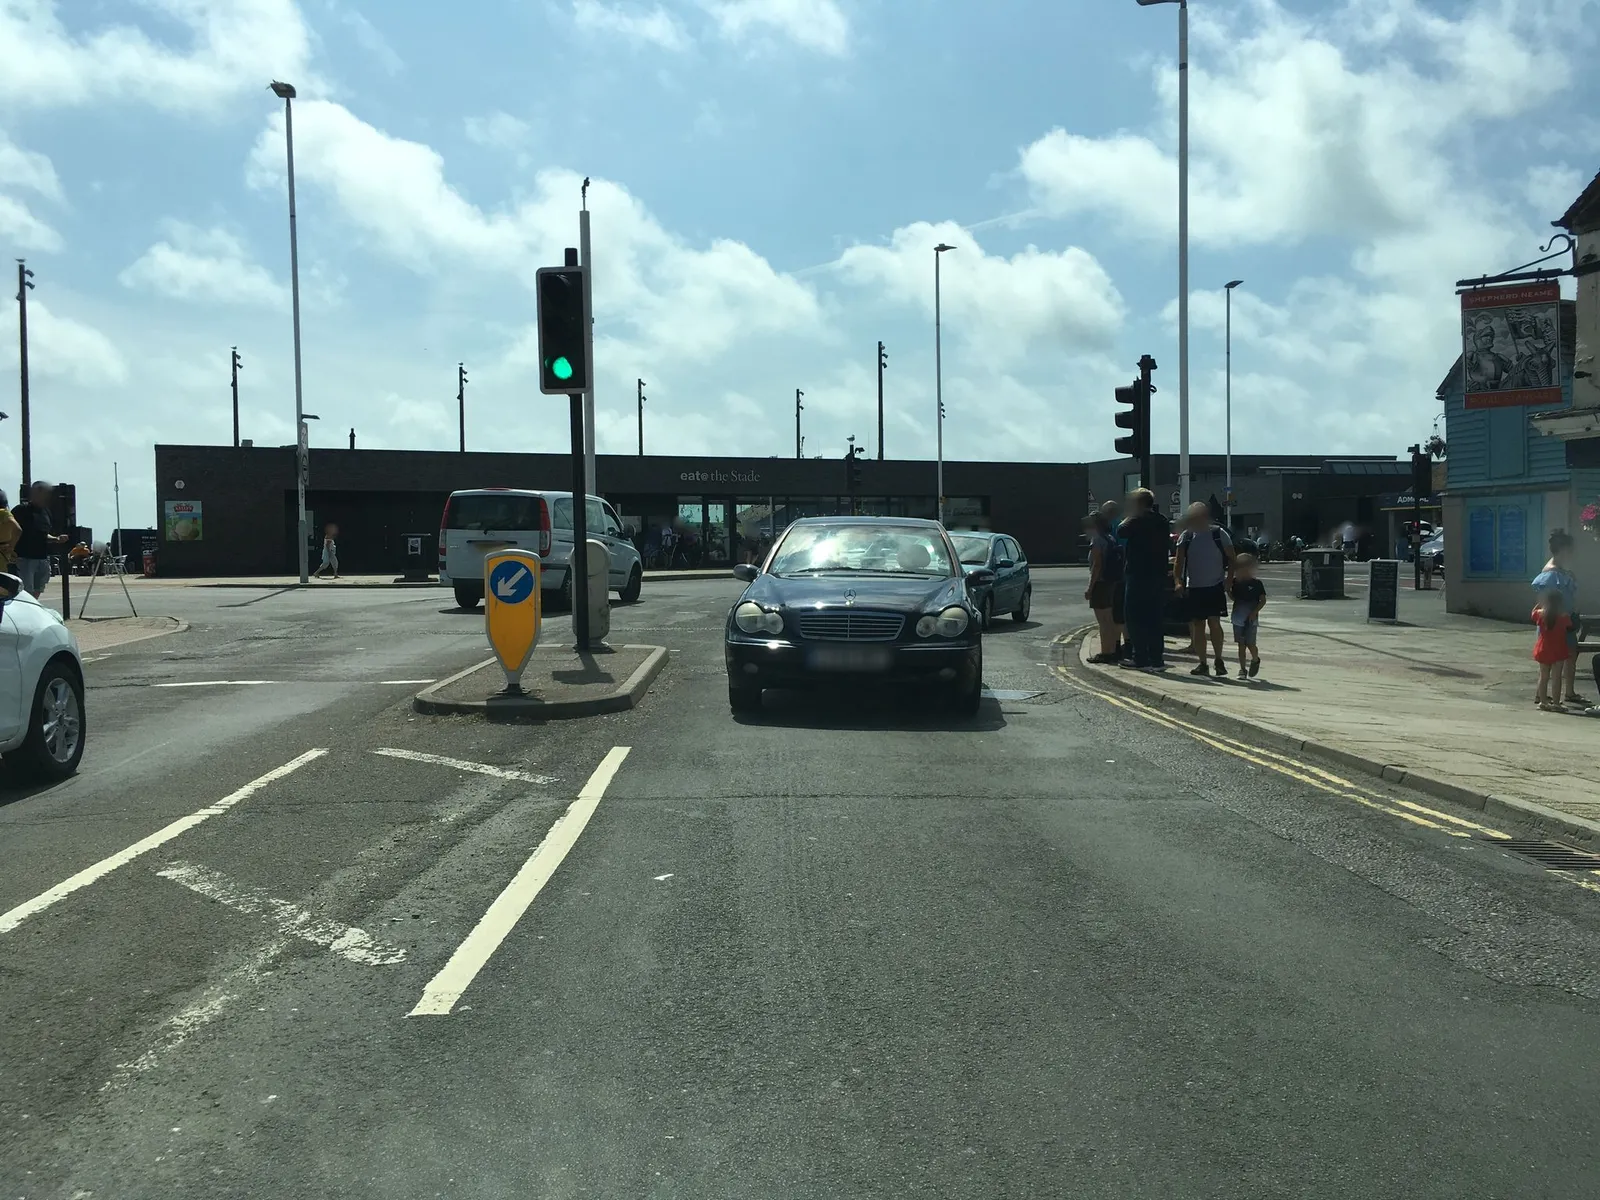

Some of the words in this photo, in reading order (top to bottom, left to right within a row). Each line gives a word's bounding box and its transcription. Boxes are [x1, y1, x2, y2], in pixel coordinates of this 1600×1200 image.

[1469, 293, 1518, 304] SHEPHERD
[1521, 289, 1554, 298] NEAME
[710, 469, 728, 482] the
[731, 469, 760, 482] Stade
